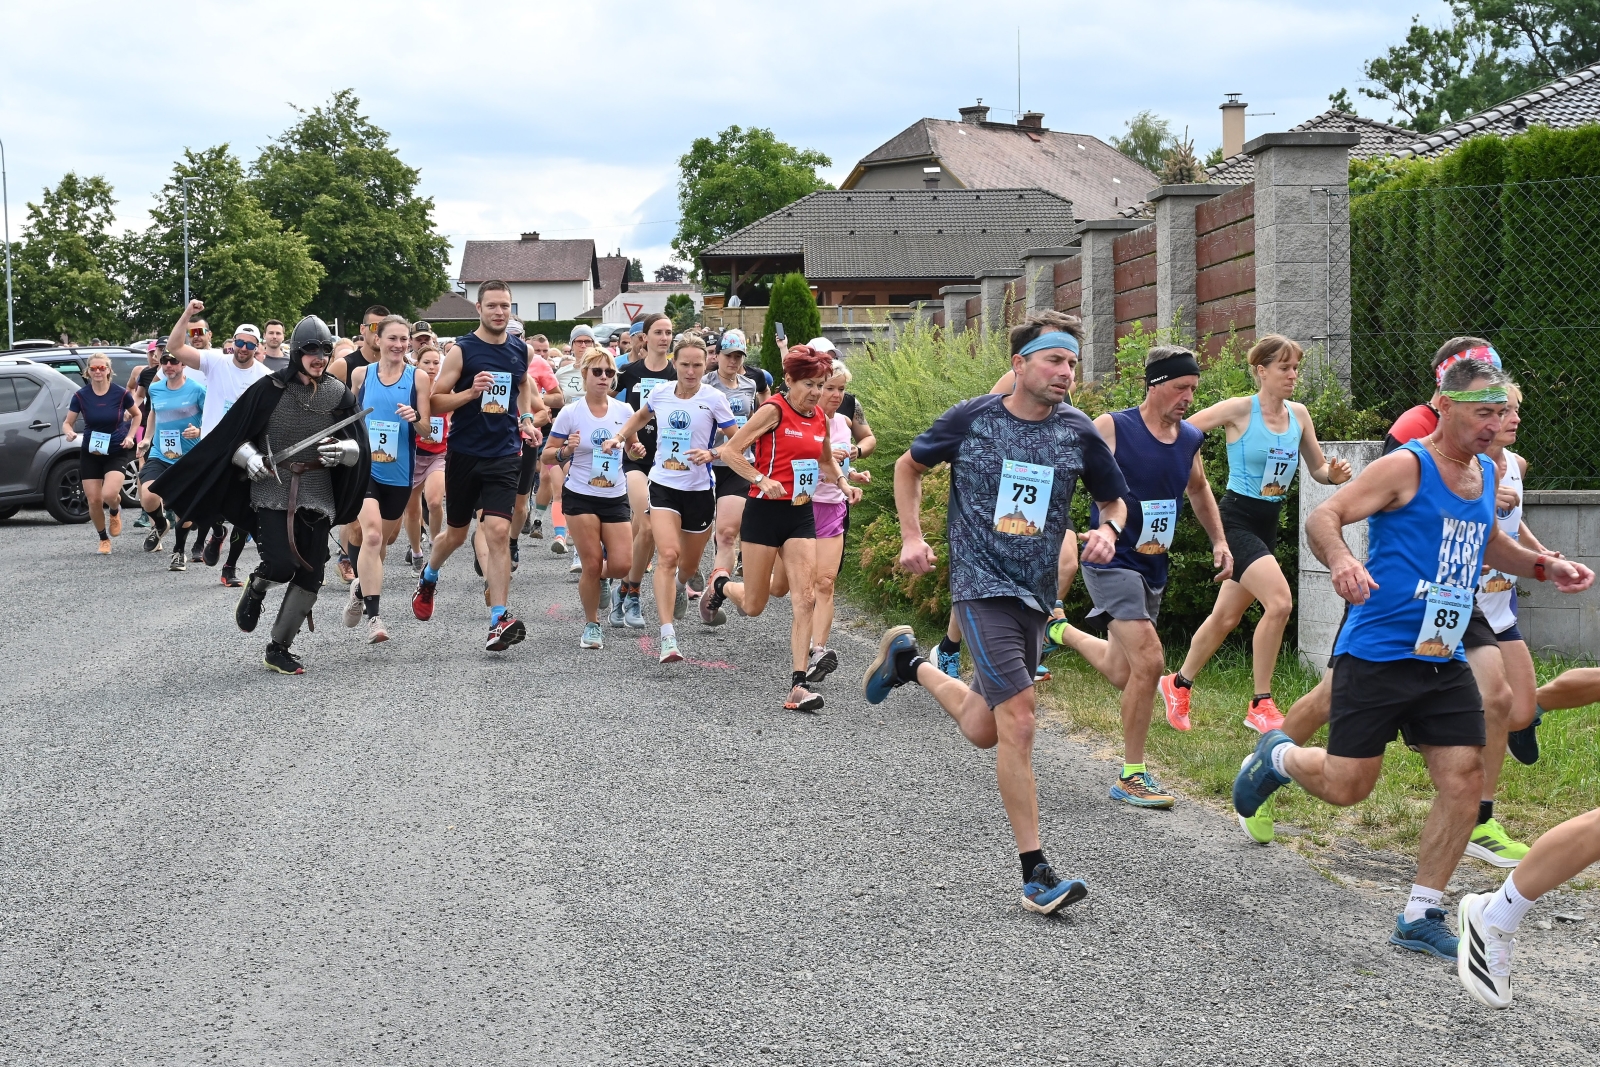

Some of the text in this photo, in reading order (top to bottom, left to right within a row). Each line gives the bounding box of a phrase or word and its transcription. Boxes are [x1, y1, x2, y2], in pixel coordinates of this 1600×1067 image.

[95, 440, 104, 449] 21
[164, 438, 176, 447] 35
[379, 432, 387, 444] 3
[671, 441, 680, 453] 2
[602, 460, 610, 472] 4
[1273, 462, 1289, 476] 17
[799, 472, 813, 486] 84
[1012, 482, 1038, 505] 73
[1150, 516, 1169, 533] 45
[1442, 517, 1488, 546] WORK
[1438, 539, 1480, 566] HARD
[1435, 561, 1477, 588] PLAY
[1433, 608, 1460, 630] 83
